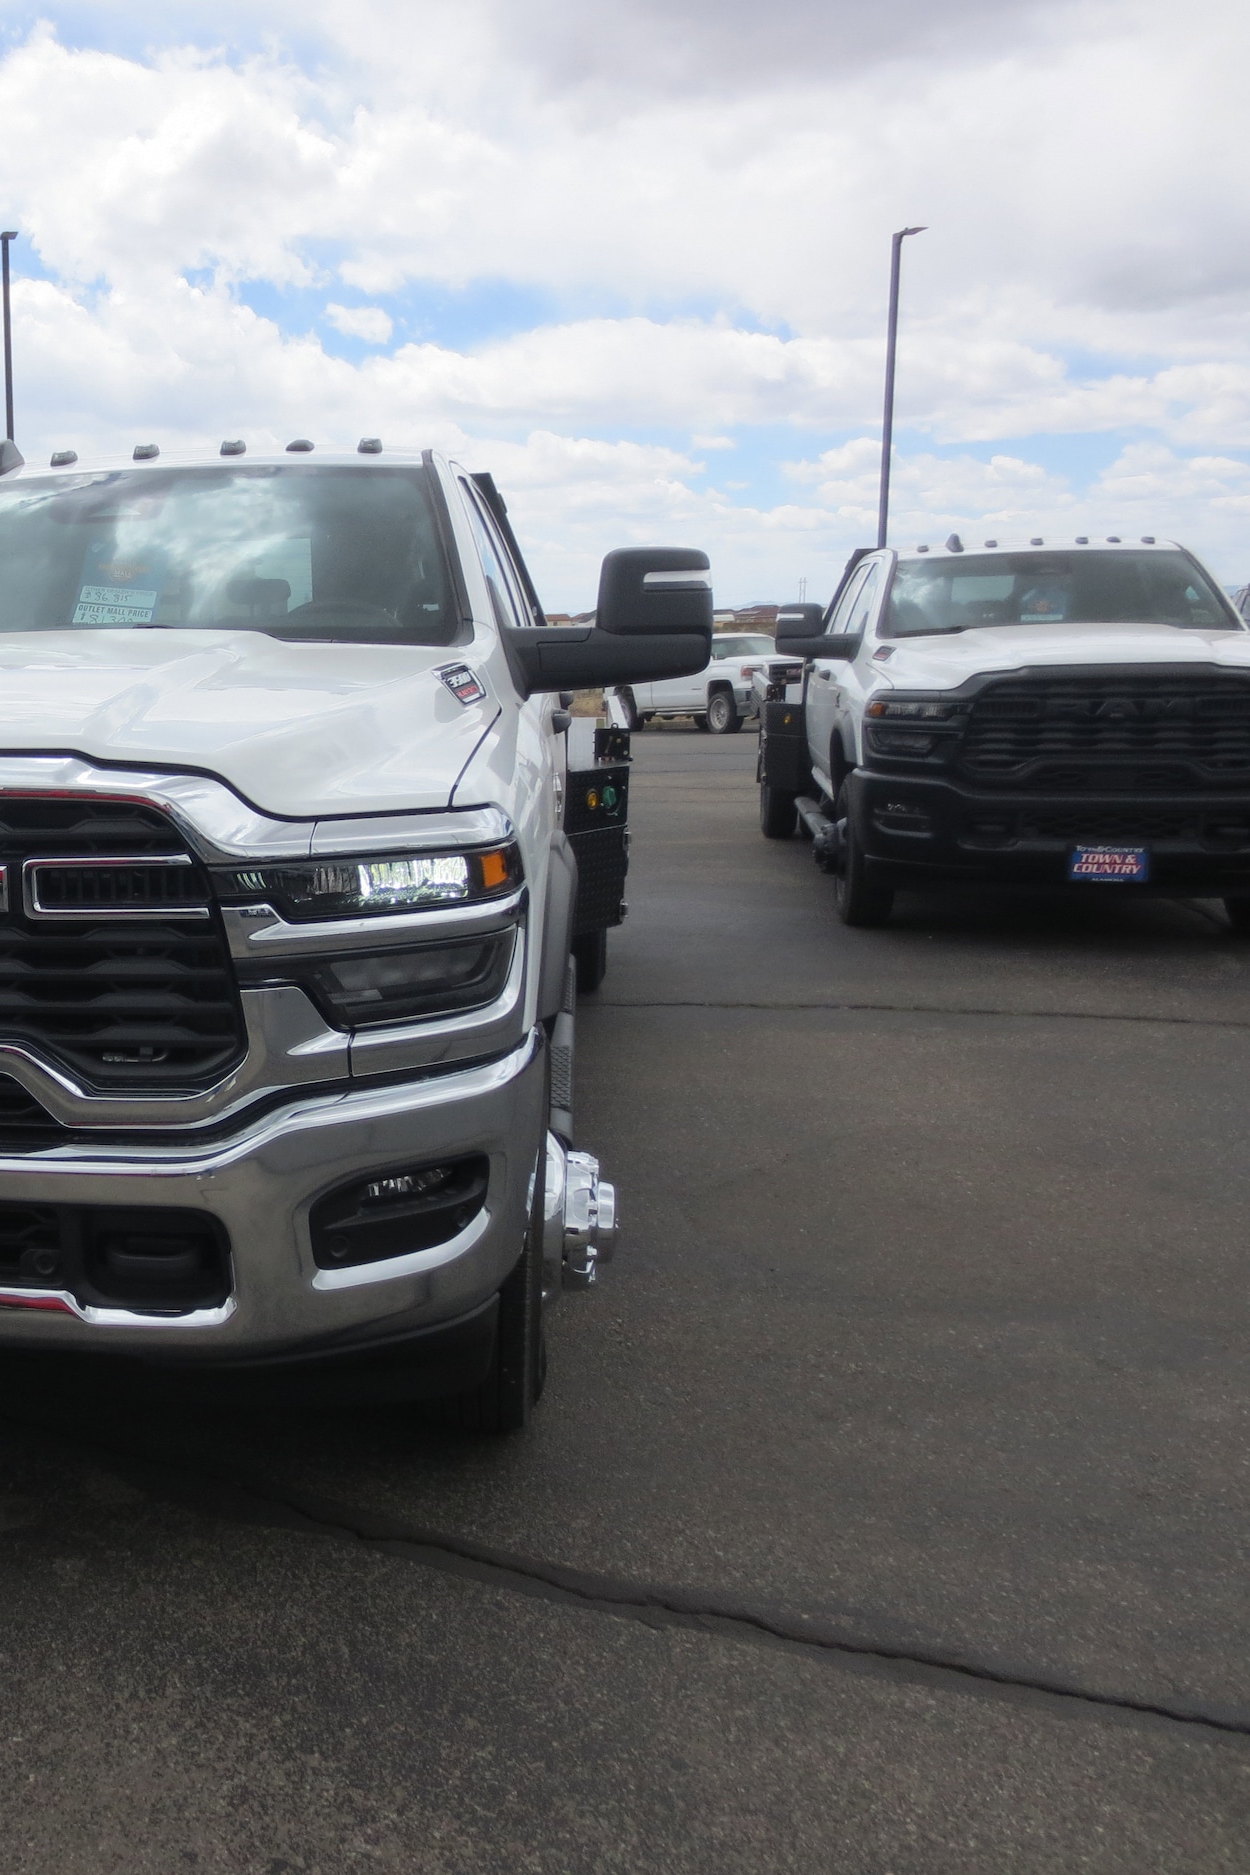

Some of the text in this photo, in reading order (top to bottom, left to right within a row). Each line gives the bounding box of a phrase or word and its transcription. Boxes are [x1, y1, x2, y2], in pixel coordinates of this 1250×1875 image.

[78, 604, 150, 618] OUTLET MALL PRICE
[1080, 853, 1137, 864] TOWN &
[1072, 863, 1141, 874] COUNTRY
